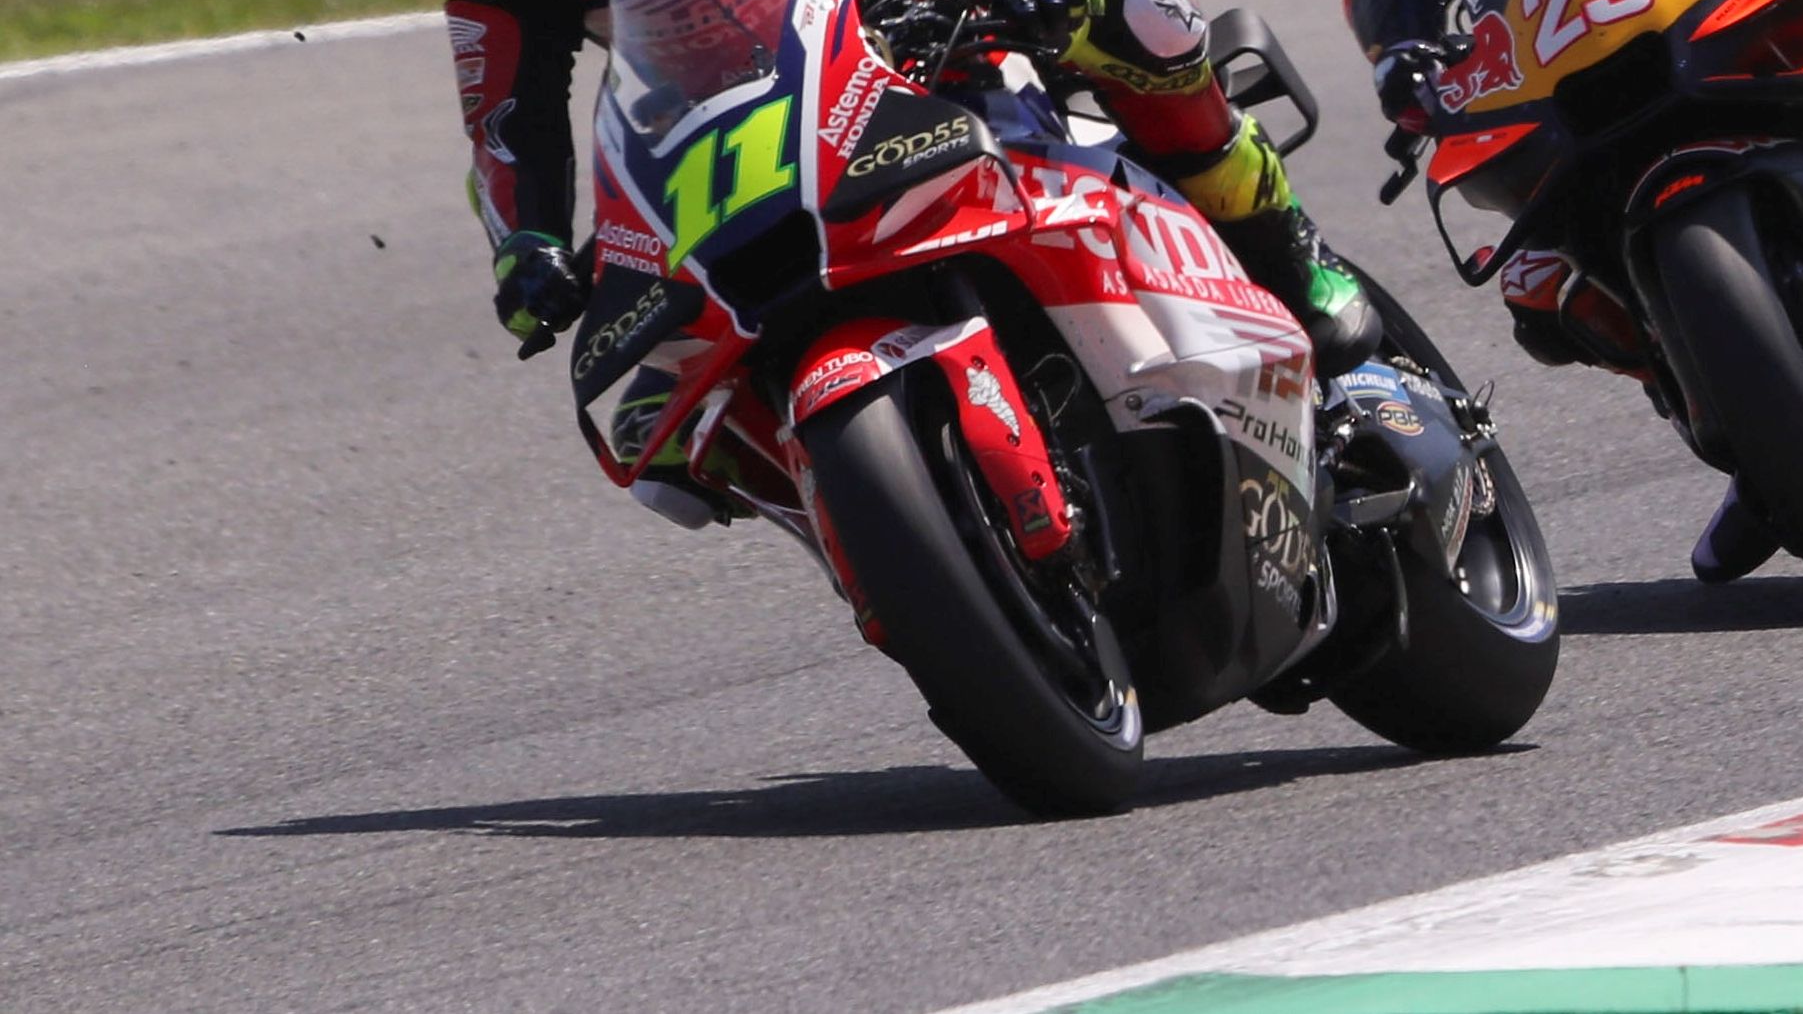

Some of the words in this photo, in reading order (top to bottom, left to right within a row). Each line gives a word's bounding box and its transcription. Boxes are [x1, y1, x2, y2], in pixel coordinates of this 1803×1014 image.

[817, 56, 878, 147] Astemo
[836, 75, 890, 160] HONDA
[902, 135, 970, 170] SPORTS
[665, 94, 797, 277] 11
[601, 248, 662, 277] HONDA
[1102, 269, 1128, 297] AS
[824, 351, 874, 372] TUBO
[1338, 372, 1398, 392] MICHELIN
